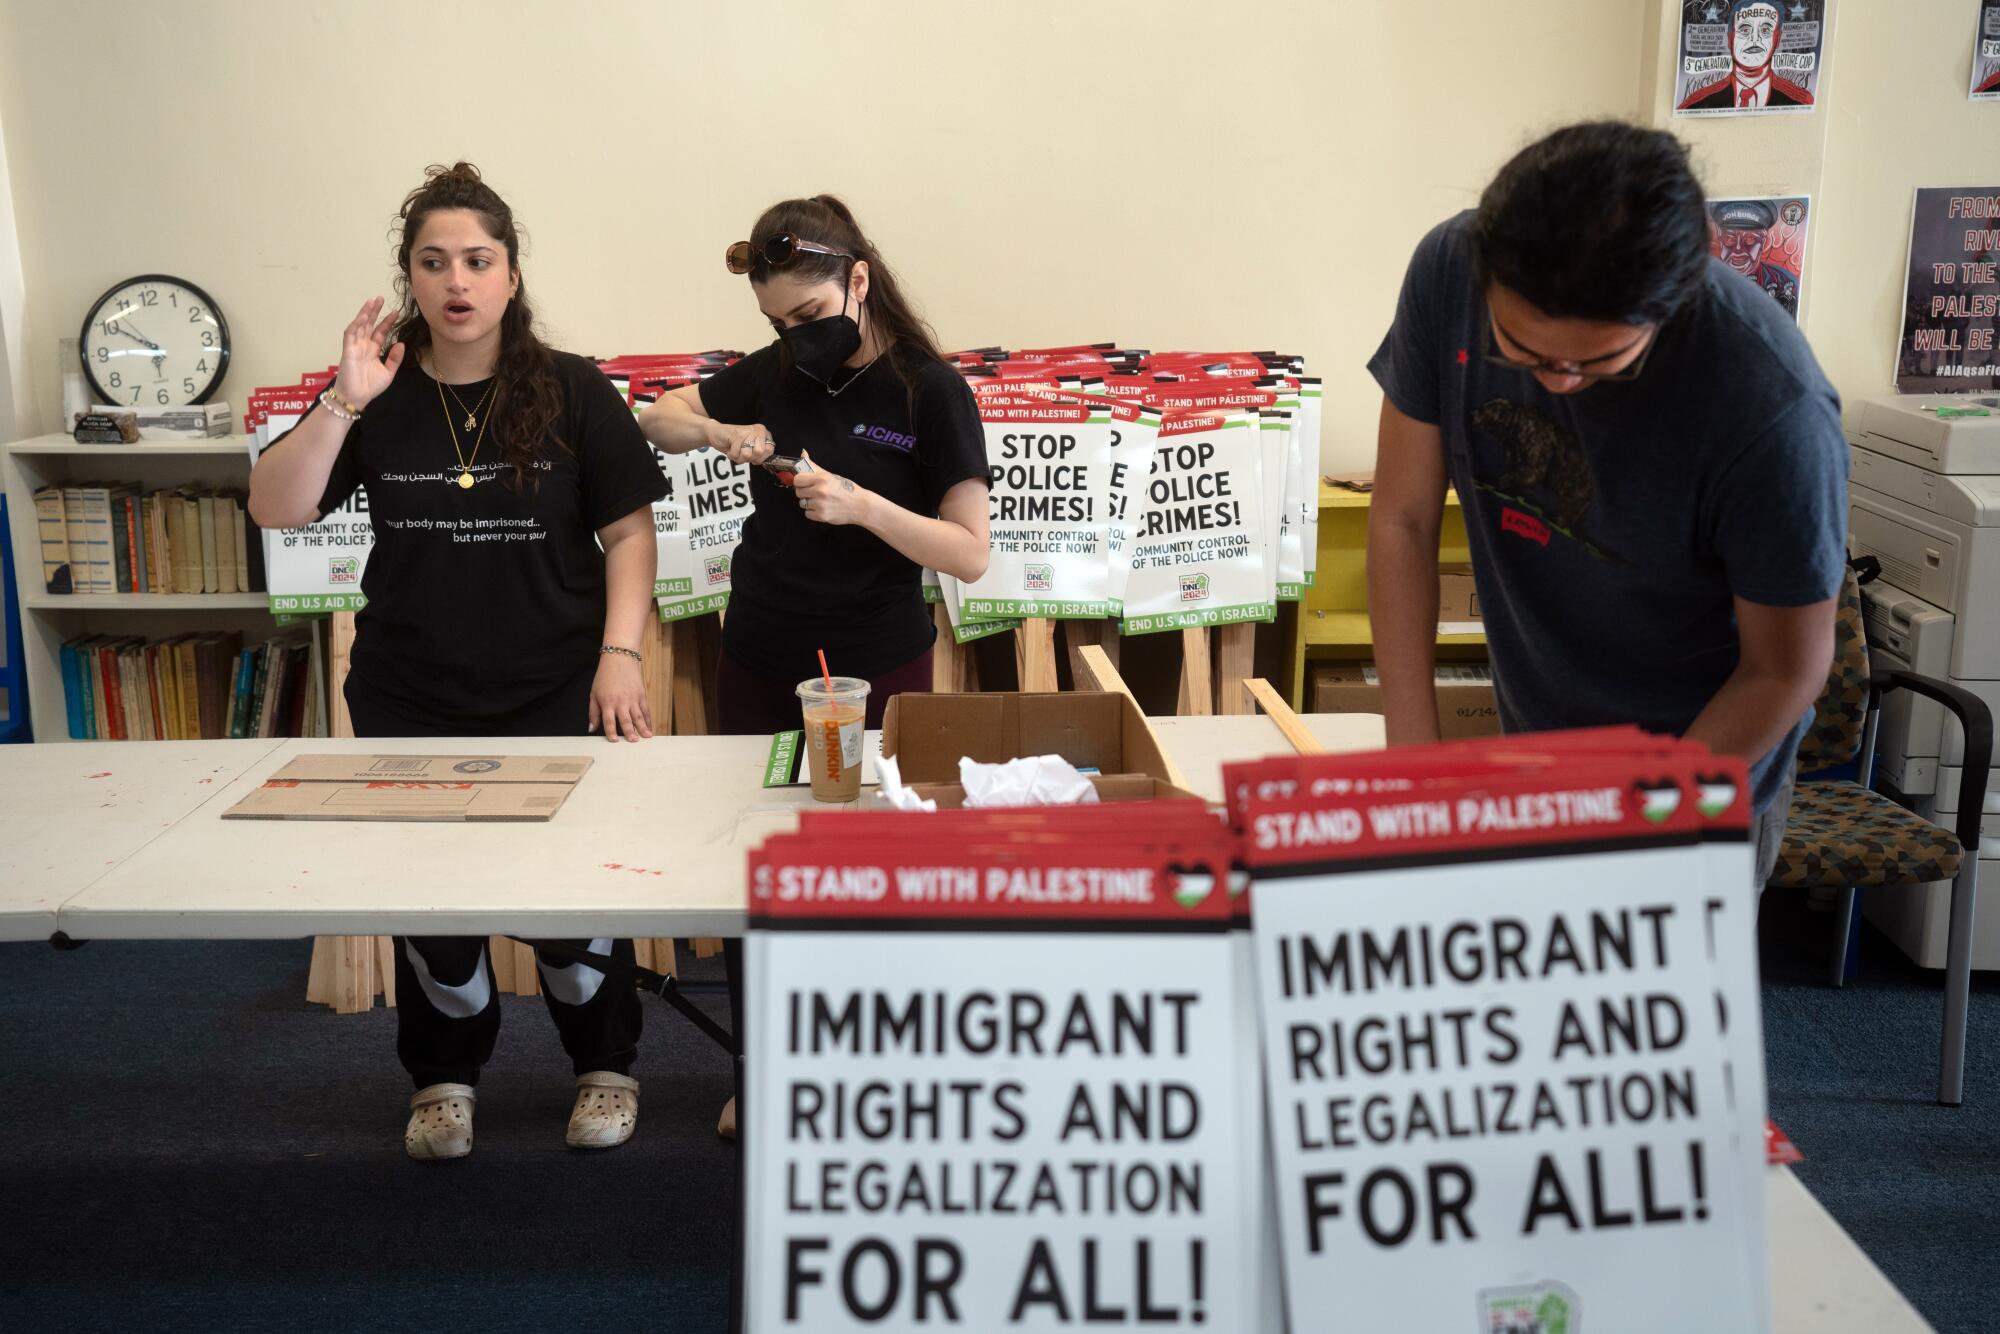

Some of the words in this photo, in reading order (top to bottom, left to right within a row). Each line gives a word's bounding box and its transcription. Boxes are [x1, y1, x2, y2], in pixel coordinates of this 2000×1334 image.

[1736, 8, 1777, 21] FORBERG
[1695, 56, 1731, 72] GENERATION
[1773, 53, 1799, 68] TORTURE
[1799, 55, 1813, 69] COP
[1933, 263, 1956, 284] TO
[1962, 262, 1996, 284] THE
[138, 290, 159, 307] 12
[169, 292, 177, 307] 1
[189, 306, 201, 323] 2
[201, 331, 214, 347] 3
[1915, 329, 1961, 351] WILL
[1968, 328, 1994, 350] BE
[97, 347, 109, 363] 9
[196, 359, 208, 374] 4
[110, 371, 122, 388] 8
[184, 377, 195, 394] 5
[130, 385, 141, 402] 7
[157, 388, 169, 405] 6
[981, 397, 1011, 405] STAND
[1028, 389, 1057, 400] STAND
[1164, 398, 1192, 407] STAND
[1195, 397, 1217, 406] WITH
[1219, 394, 1268, 405] PALESTINE!
[273, 401, 303, 410] STAND
[981, 409, 1004, 417] TAND
[1008, 410, 1030, 418] WITH
[1032, 409, 1080, 418] PALESTINE!
[1167, 416, 1216, 431] PALESTINE!
[1001, 433, 1076, 460] STOP
[687, 455, 745, 487] LICE
[991, 464, 1088, 491] POLICE
[1146, 471, 1232, 505] OLICE
[688, 480, 756, 519] IMES!
[654, 510, 680, 520] TROL
[989, 495, 1094, 522] CRIMES!
[280, 523, 347, 535] COMMUNITY
[406, 518, 433, 530] body
[436, 521, 458, 530] may
[460, 519, 473, 529] be
[657, 522, 678, 533] OW!
[284, 537, 298, 547] OF
[303, 536, 323, 546] THE
[328, 535, 366, 546] POLICE
[453, 533, 471, 542] but
[473, 533, 501, 542] never
[504, 532, 527, 542] your
[529, 531, 547, 541] soul
[700, 531, 733, 549] POLICE
[989, 530, 1043, 541] OMMUNITY
[1047, 531, 1099, 541] CONTROL
[1000, 542, 1019, 552] THE
[1024, 543, 1062, 553] POLICE
[1066, 543, 1096, 553] NOW!
[1132, 541, 1193, 558] OMMUNITY
[1198, 534, 1250, 549] CONTROL
[1132, 559, 1146, 569] OF
[1151, 557, 1171, 568] THE
[1176, 552, 1214, 566] POLICE
[1218, 548, 1248, 559] NOW!
[331, 574, 355, 582] 2024
[709, 572, 731, 583] 2024
[655, 581, 690, 594] SRAEL!
[1182, 583, 1200, 591] DNC
[1183, 590, 1207, 599] 2024
[275, 598, 298, 609] END
[302, 598, 320, 609] U.S
[325, 598, 345, 608] AID
[349, 596, 365, 607] TO
[664, 605, 684, 618] END
[688, 600, 704, 613] U.S
[708, 596, 725, 610] AID
[969, 602, 993, 613] END
[996, 602, 1014, 614] U.S
[1019, 602, 1039, 614] AID
[1042, 603, 1058, 614] TO
[1062, 604, 1105, 616] ISRAEL!
[1129, 620, 1152, 631] END
[1156, 616, 1175, 628] U.S
[1179, 614, 1199, 625] AID
[1202, 611, 1217, 622] TO
[1222, 606, 1265, 620] ISRAEL!
[959, 624, 981, 638] END
[779, 733, 794, 742] END
[773, 759, 788, 767] TO
[775, 751, 790, 759] AID
[1256, 809, 1363, 850] STAND
[1370, 800, 1452, 839] WITH
[1458, 788, 1624, 833] PALESTINE
[778, 866, 887, 900] STAND
[896, 867, 976, 901] WITH
[985, 867, 1154, 903] PALESTINE
[1279, 905, 1675, 1000] IMMIGRANT
[788, 990, 1201, 1056] IMMIGRANT
[1288, 1007, 1523, 1082] RIGHTS
[1553, 989, 1688, 1060] AND
[787, 1081, 1030, 1142] RIGHTS
[1060, 1081, 1202, 1142] AND
[1297, 1068, 1699, 1152] LEGALIZATION
[786, 1161, 1204, 1214] LEGALIZATION
[1303, 1161, 1478, 1255] FOR
[1522, 1140, 1711, 1237] ALL!
[784, 1237, 965, 1324] FOR
[1010, 1237, 1208, 1324] ALL!
